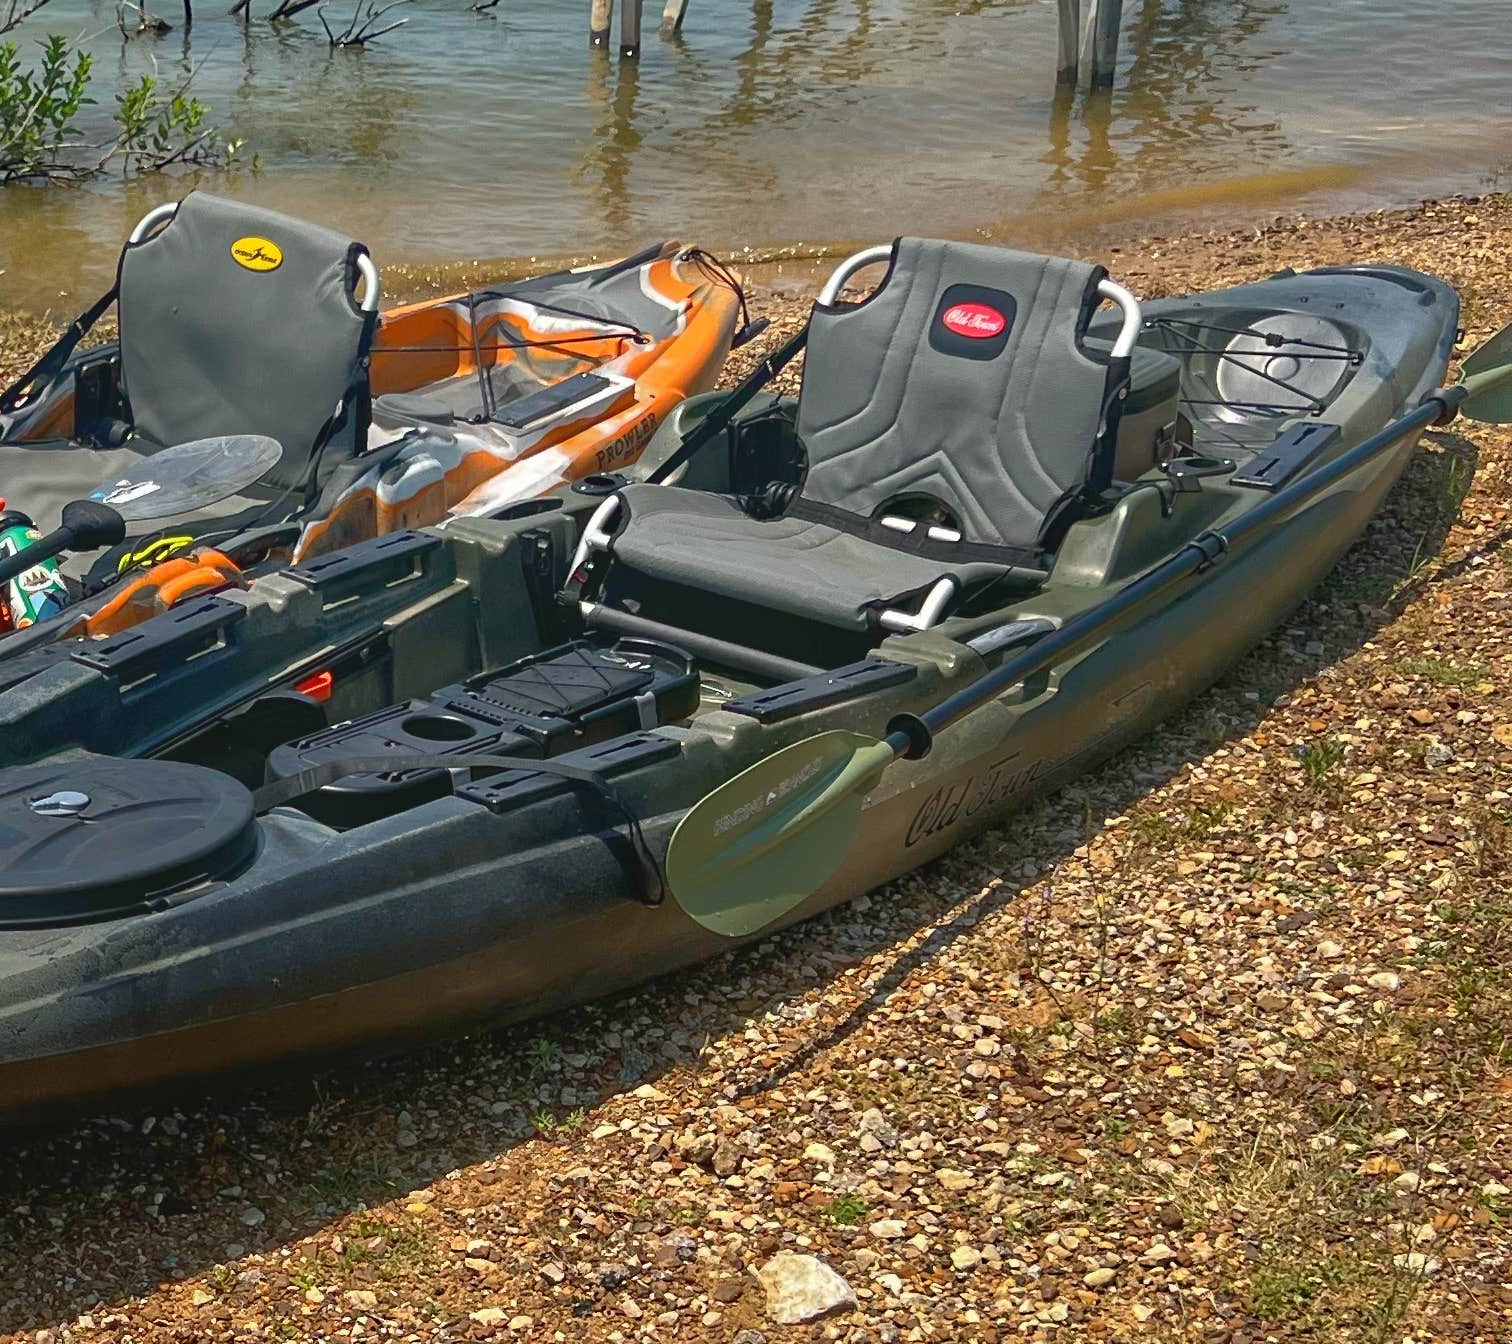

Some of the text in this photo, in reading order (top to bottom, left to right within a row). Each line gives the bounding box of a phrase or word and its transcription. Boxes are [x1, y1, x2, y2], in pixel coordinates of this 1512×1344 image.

[946, 308, 1001, 332] Old Town
[595, 412, 658, 472] PROWLER
[904, 775, 974, 848] Old
